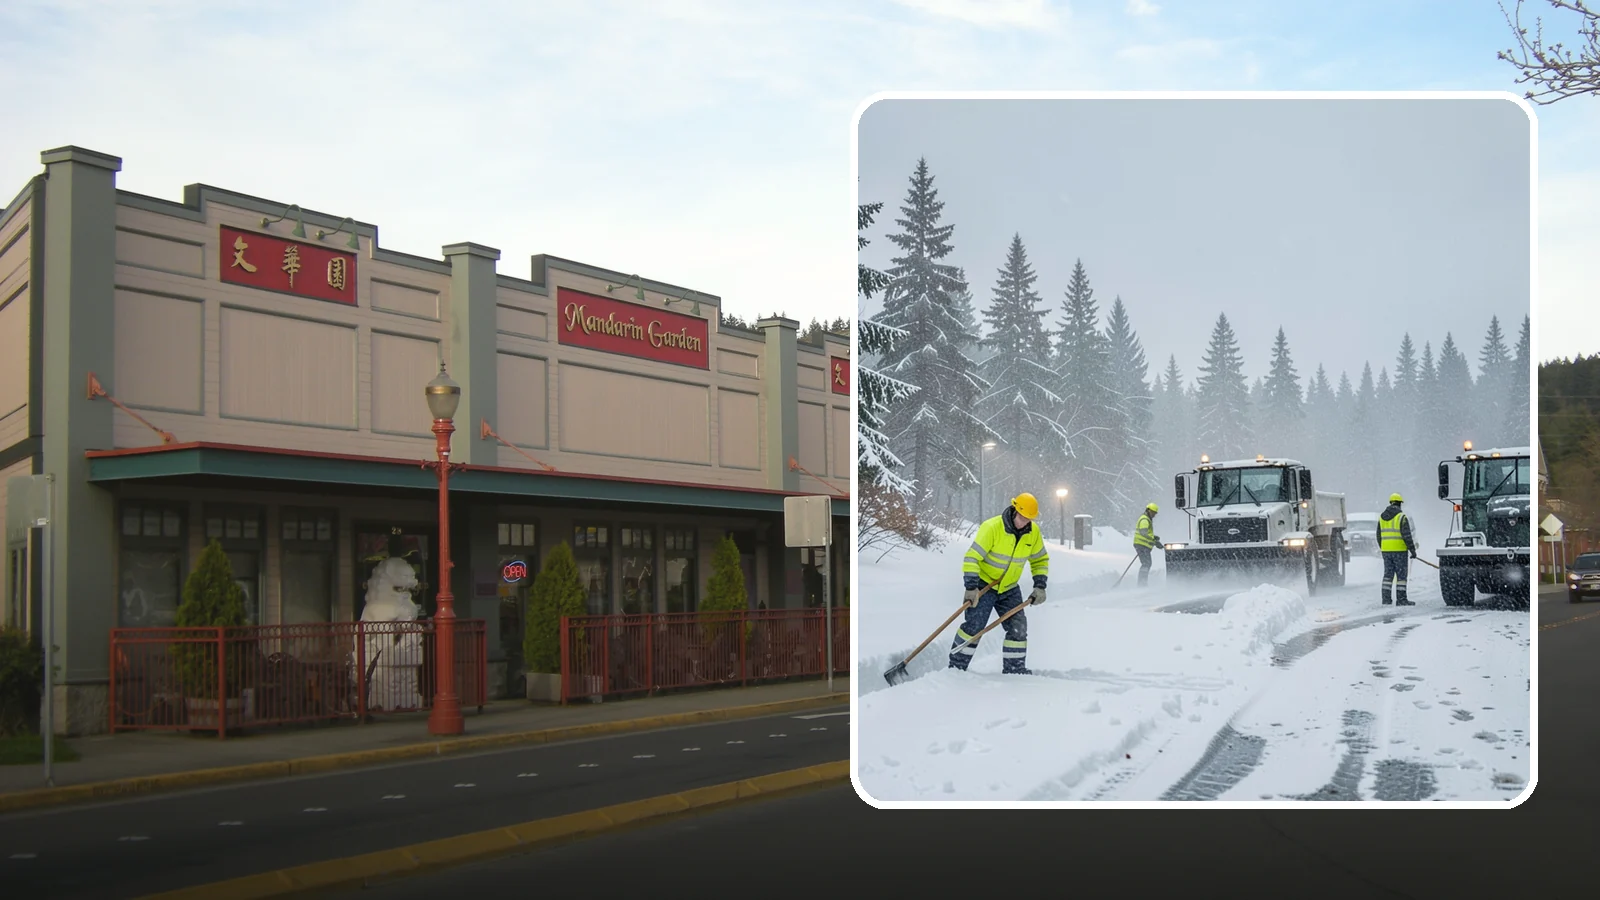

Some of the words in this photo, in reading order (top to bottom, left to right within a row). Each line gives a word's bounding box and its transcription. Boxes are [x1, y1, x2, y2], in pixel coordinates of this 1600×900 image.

[230, 235, 347, 291] 文華園
[564, 302, 644, 340] Mandarin
[648, 320, 701, 352] Garden
[503, 565, 527, 578] OPEN
